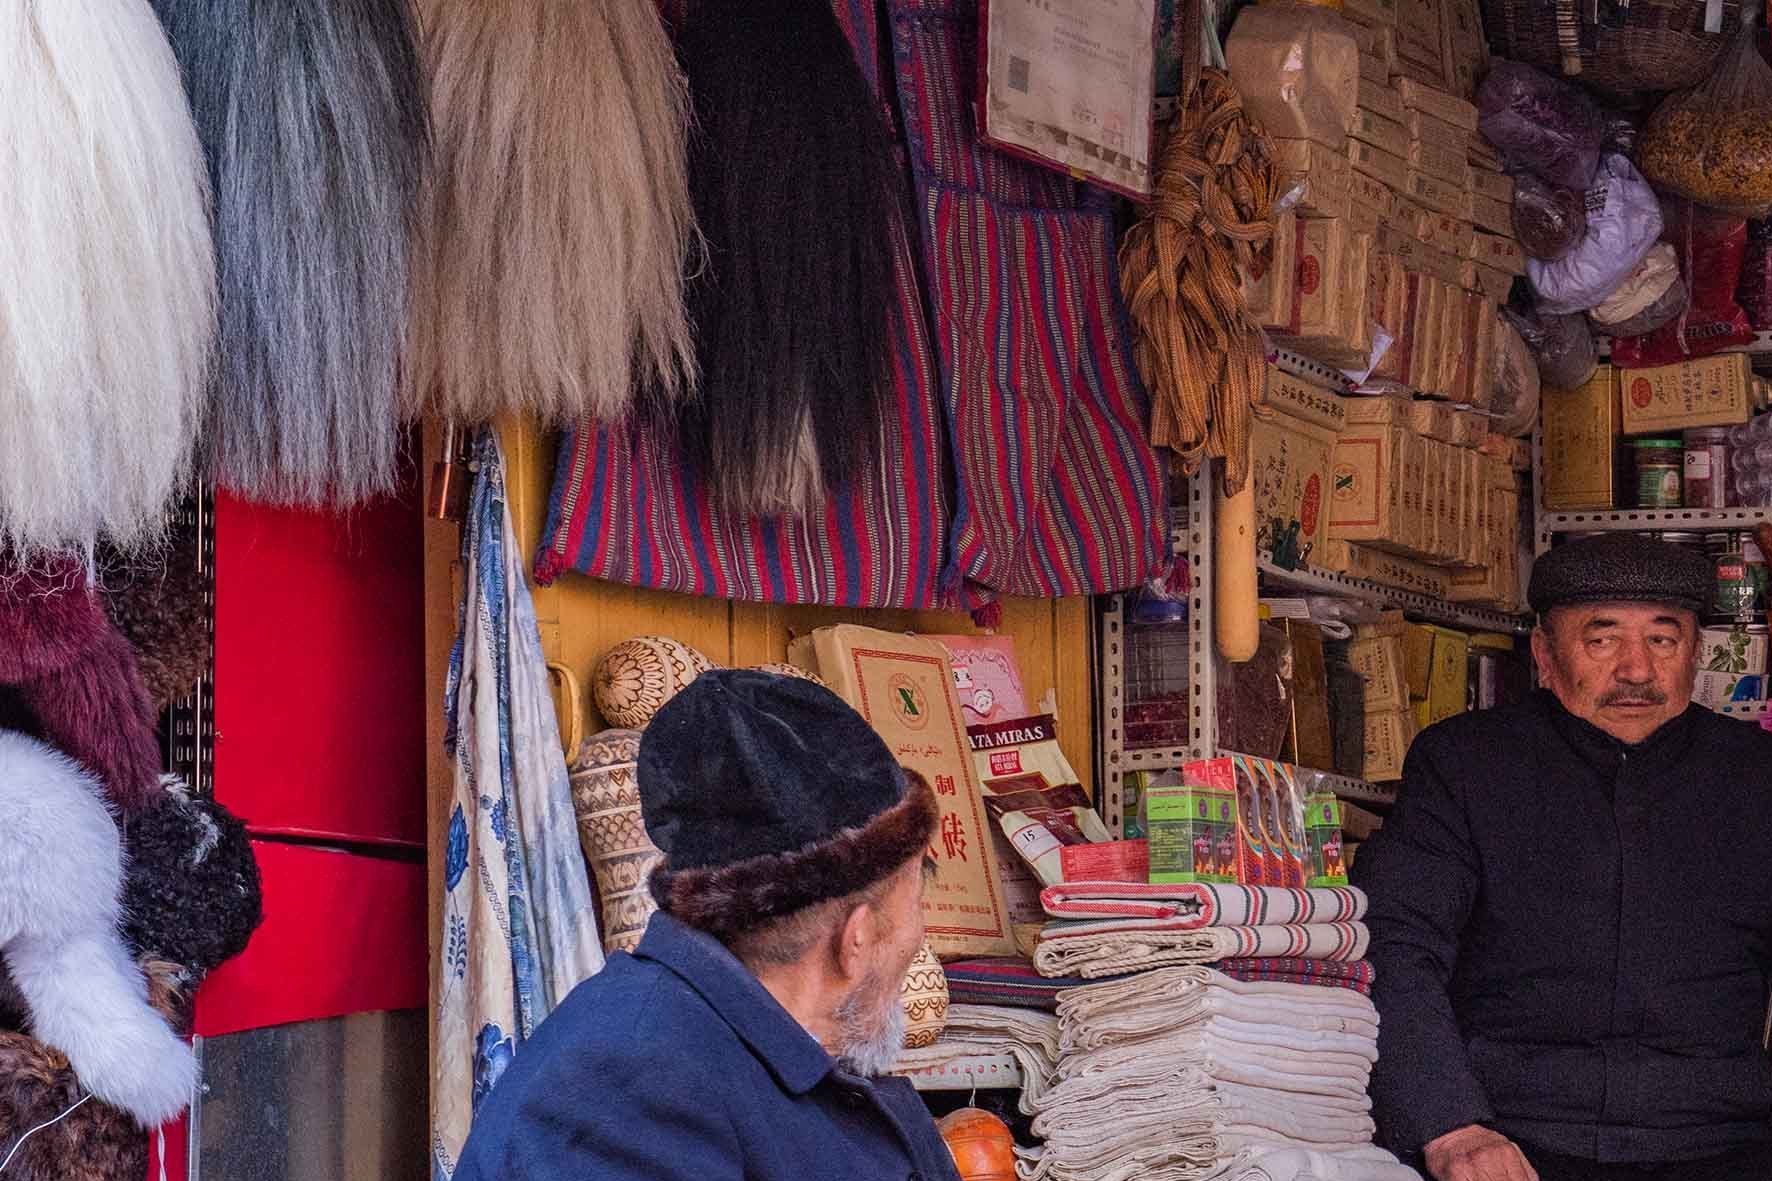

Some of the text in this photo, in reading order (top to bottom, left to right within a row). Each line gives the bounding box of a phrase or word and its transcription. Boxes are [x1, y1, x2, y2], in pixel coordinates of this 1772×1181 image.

[968, 726, 1044, 749] ATA MIRAS
[1022, 830, 1037, 842] 15
